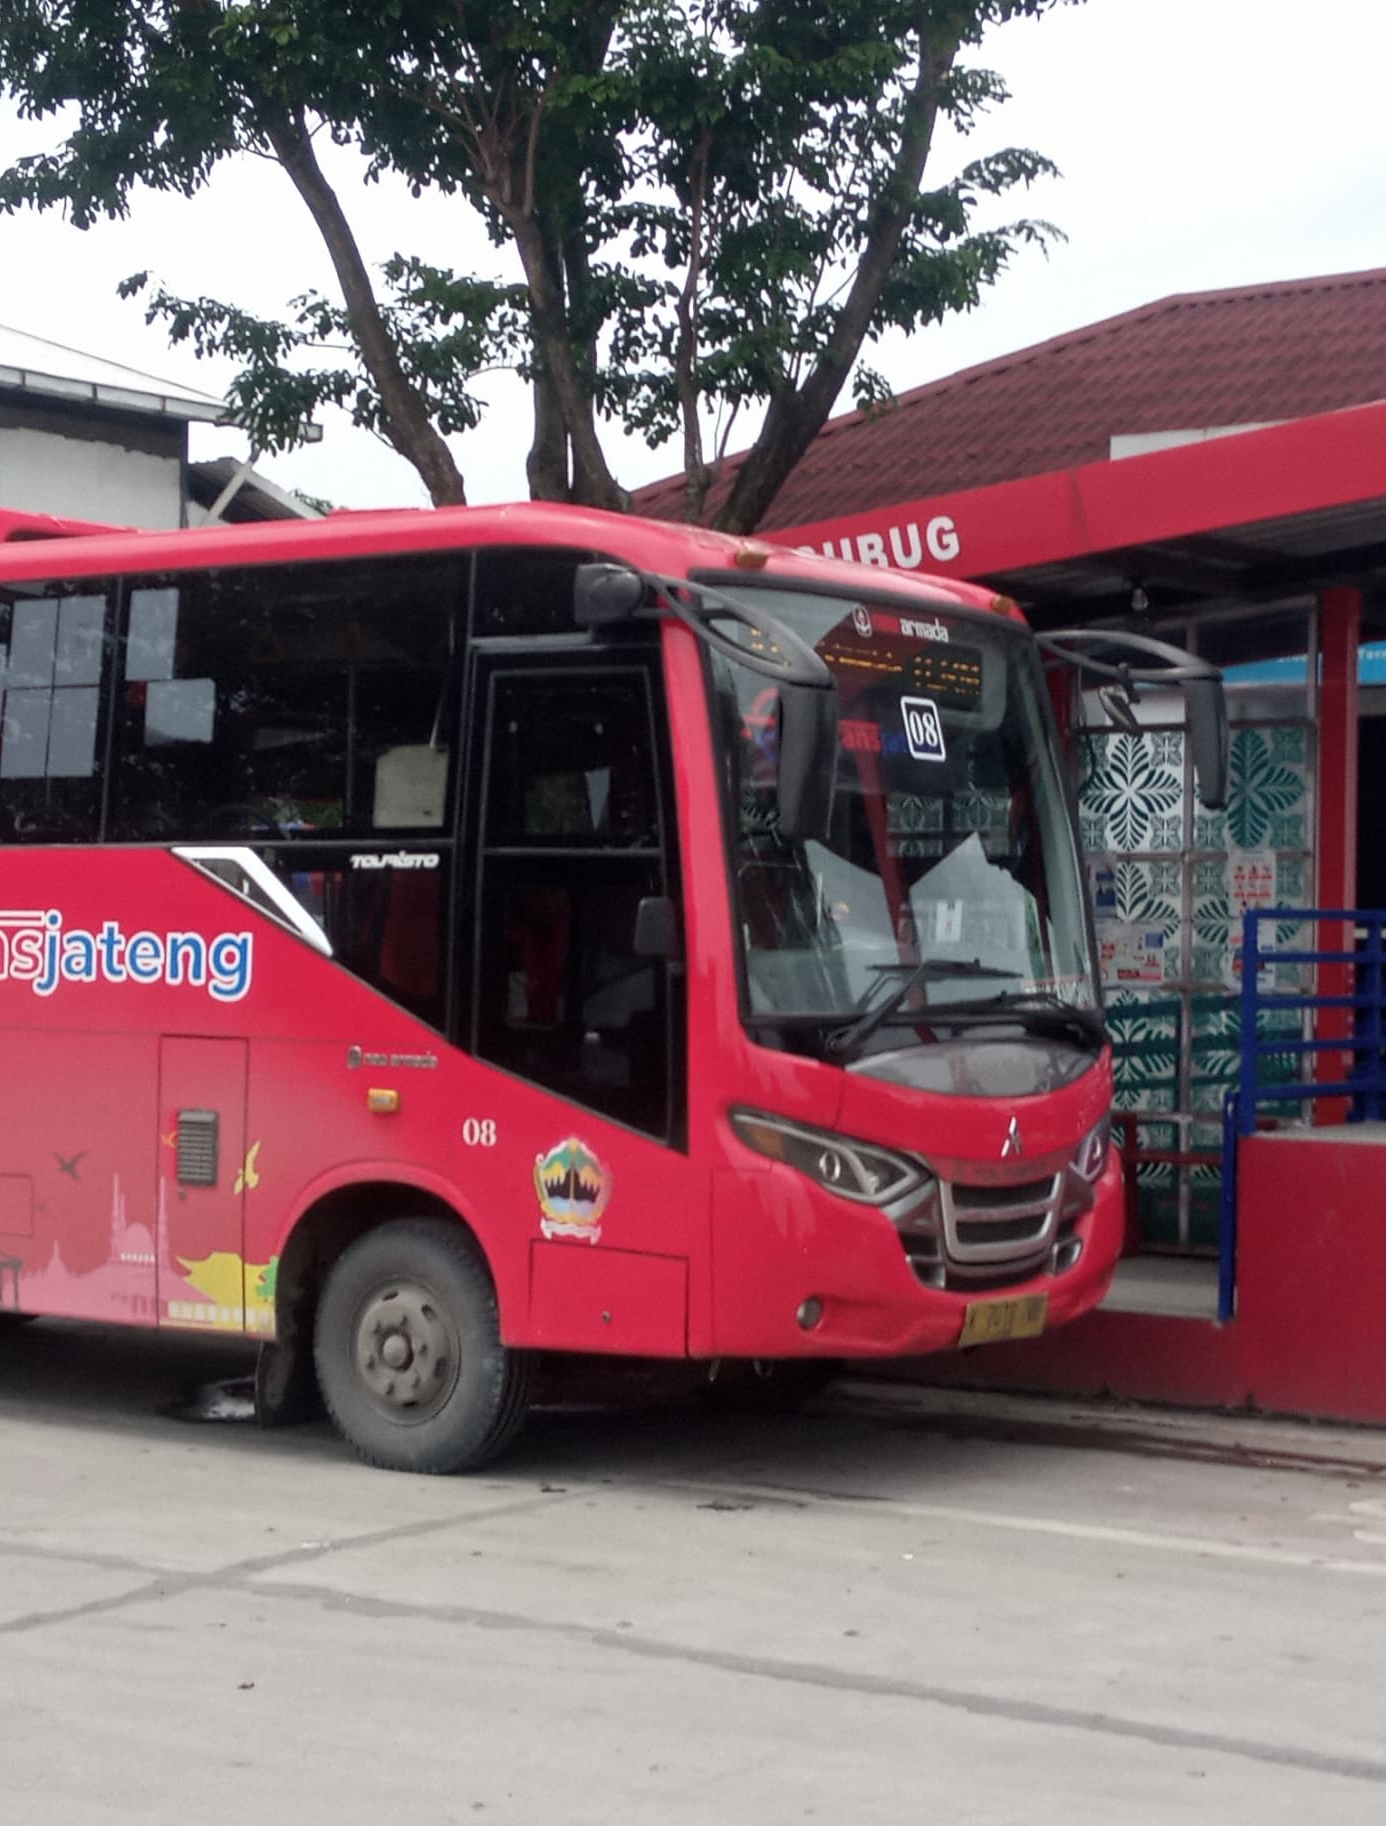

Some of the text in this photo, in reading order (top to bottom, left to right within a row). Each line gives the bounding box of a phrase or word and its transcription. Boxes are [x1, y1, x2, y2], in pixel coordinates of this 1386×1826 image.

[900, 617, 949, 643] armada
[909, 711, 938, 747] 08
[462, 1117, 497, 1147] 08
